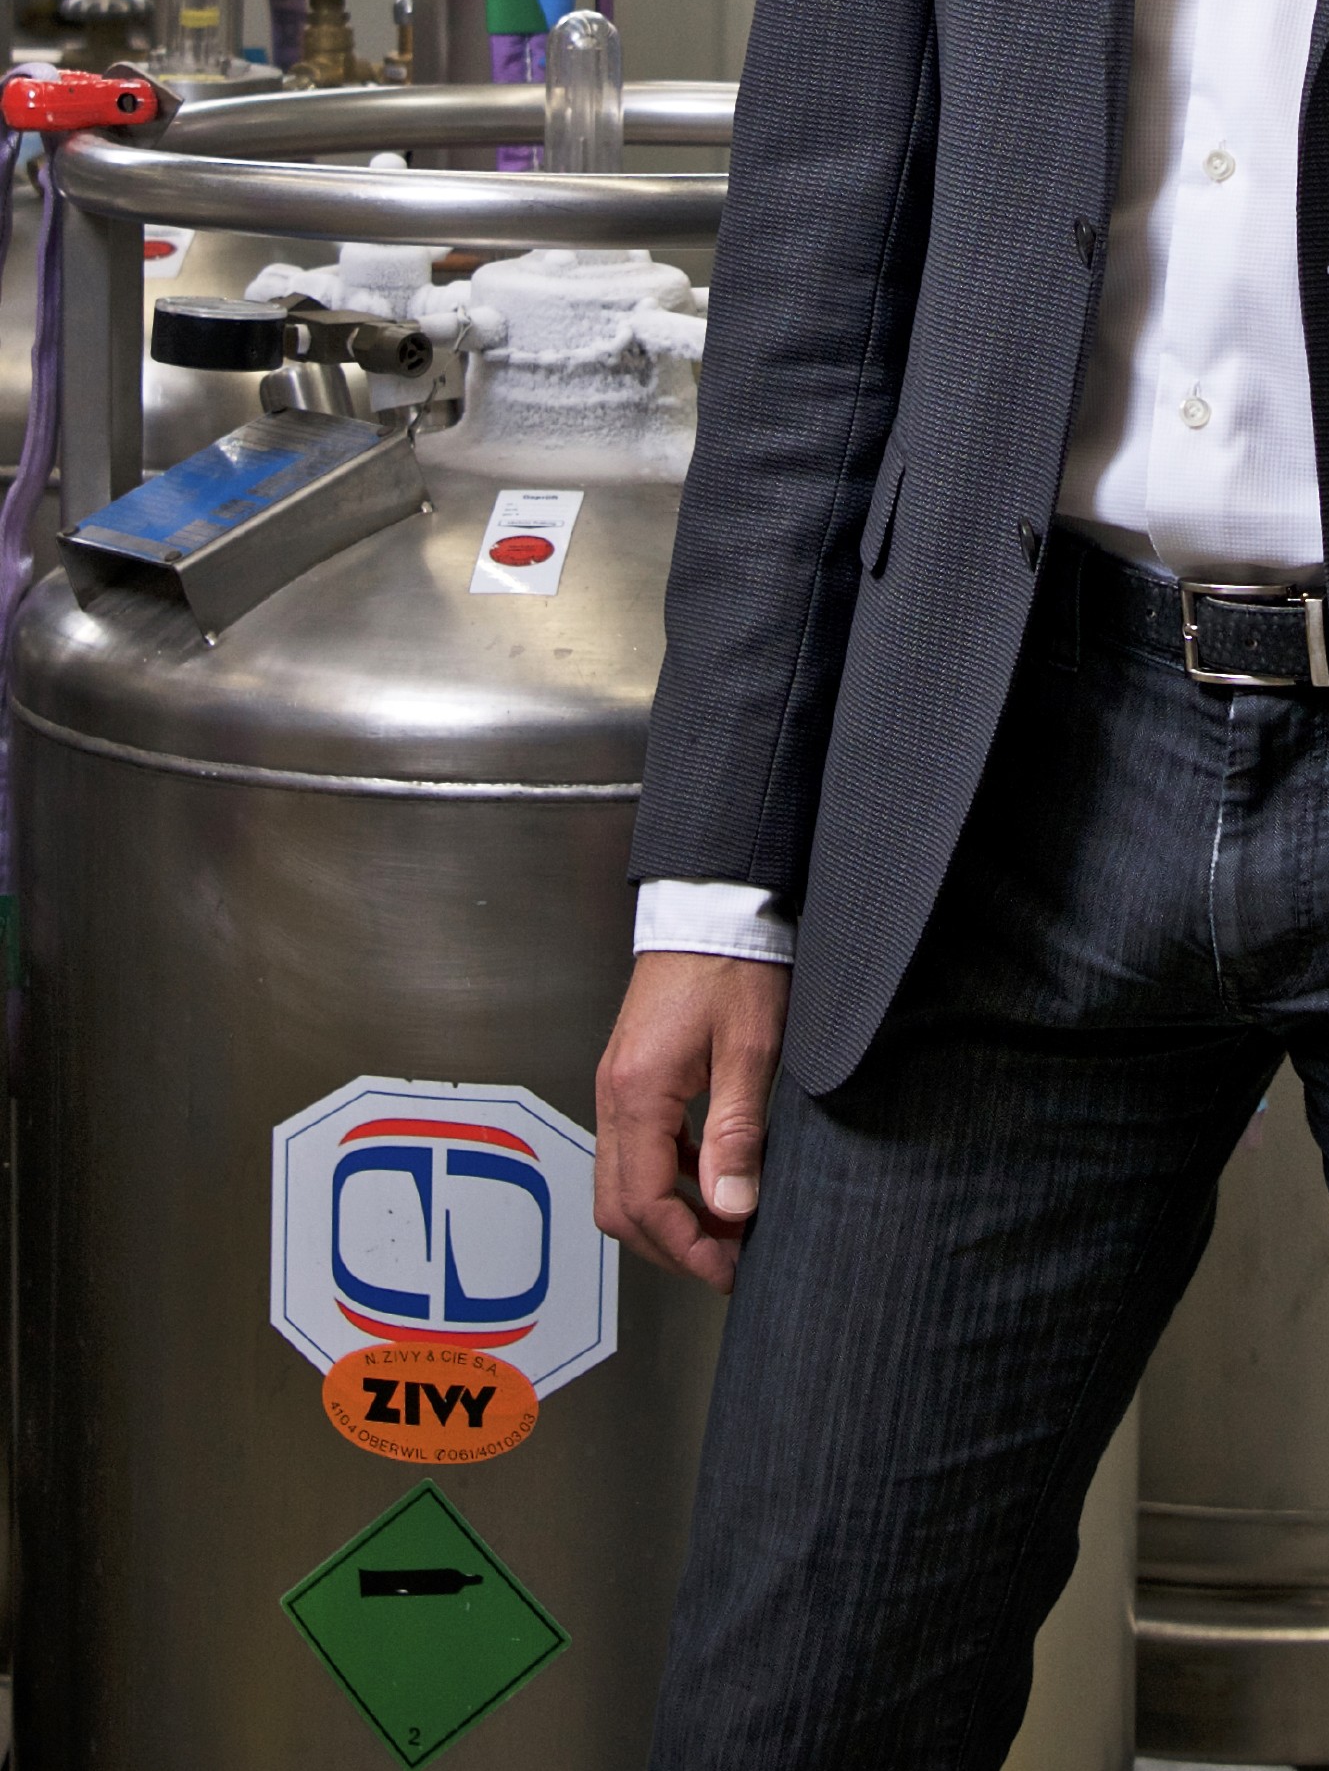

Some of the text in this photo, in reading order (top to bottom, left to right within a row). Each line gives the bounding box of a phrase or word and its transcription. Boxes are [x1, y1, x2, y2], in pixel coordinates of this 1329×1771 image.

[365, 1352, 380, 1365] N.
[383, 1350, 421, 1363] ZIVY
[426, 1350, 435, 1362] &
[441, 1350, 467, 1364] CIE
[362, 1377, 498, 1428] ZIVY
[331, 1401, 357, 1433] 4104
[358, 1429, 428, 1460] OBERWIL
[407, 1727, 421, 1746] 2
